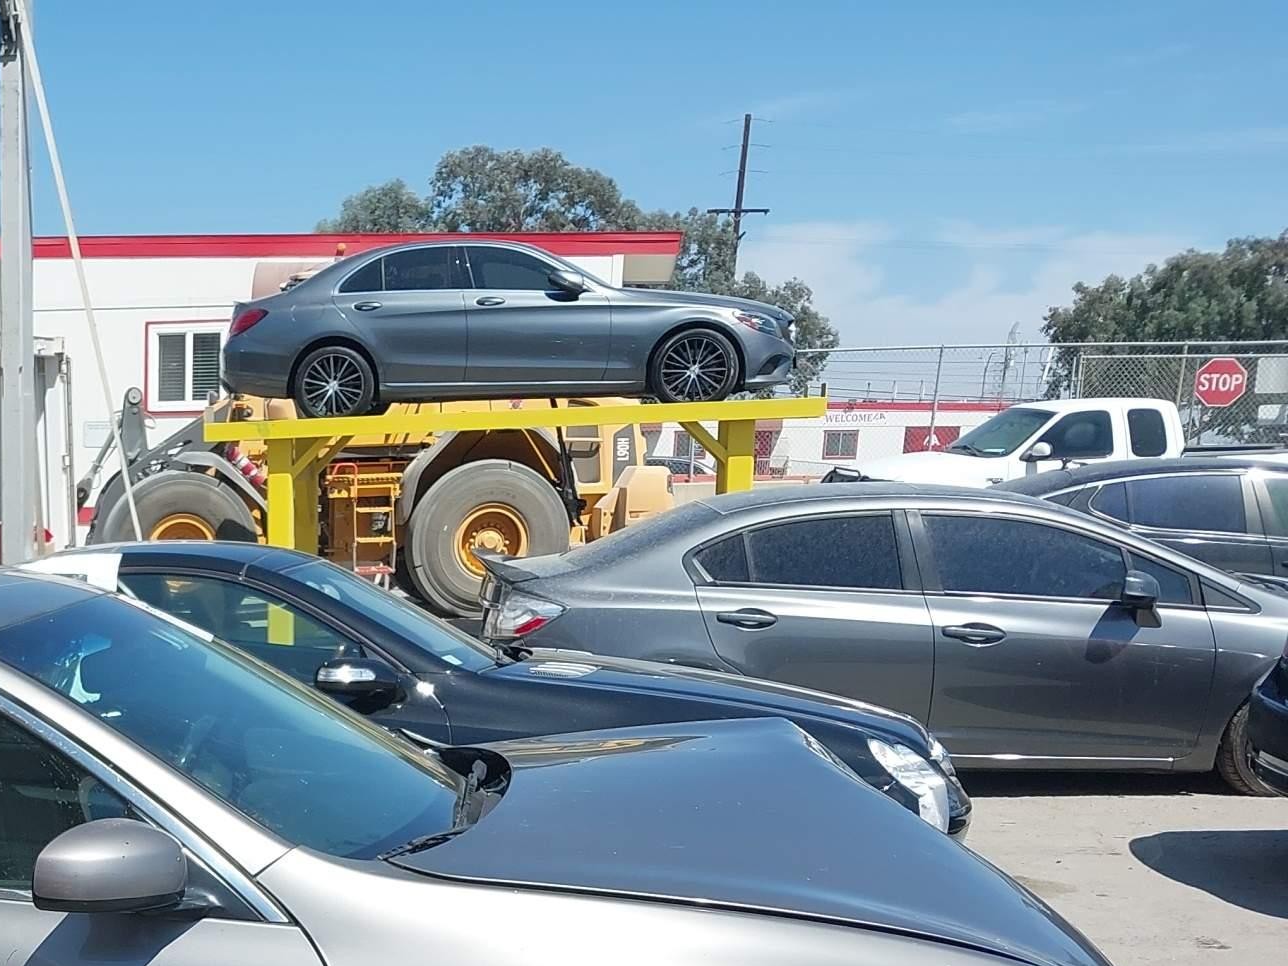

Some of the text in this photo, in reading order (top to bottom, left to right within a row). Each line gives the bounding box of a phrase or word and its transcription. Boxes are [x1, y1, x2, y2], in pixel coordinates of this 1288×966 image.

[1198, 373, 1243, 391] STOP
[825, 413, 873, 423] WELCOME
[616, 437, 630, 461] L90H
